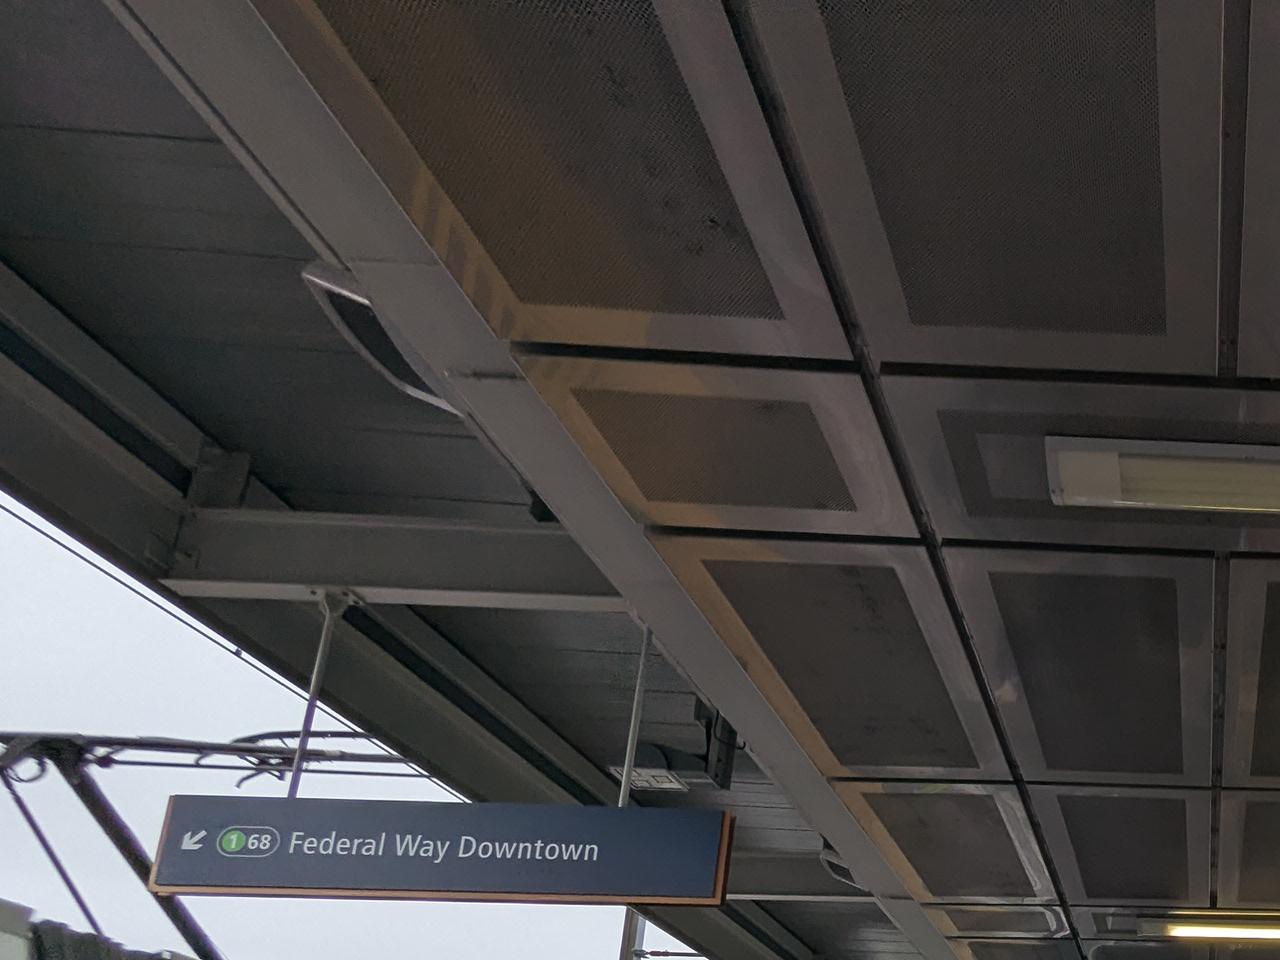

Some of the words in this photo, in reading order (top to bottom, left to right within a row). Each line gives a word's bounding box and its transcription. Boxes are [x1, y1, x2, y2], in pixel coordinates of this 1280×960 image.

[247, 834, 272, 850] 68
[288, 831, 386, 856] Federal
[395, 833, 451, 864] Way
[458, 835, 598, 861] Downtown
